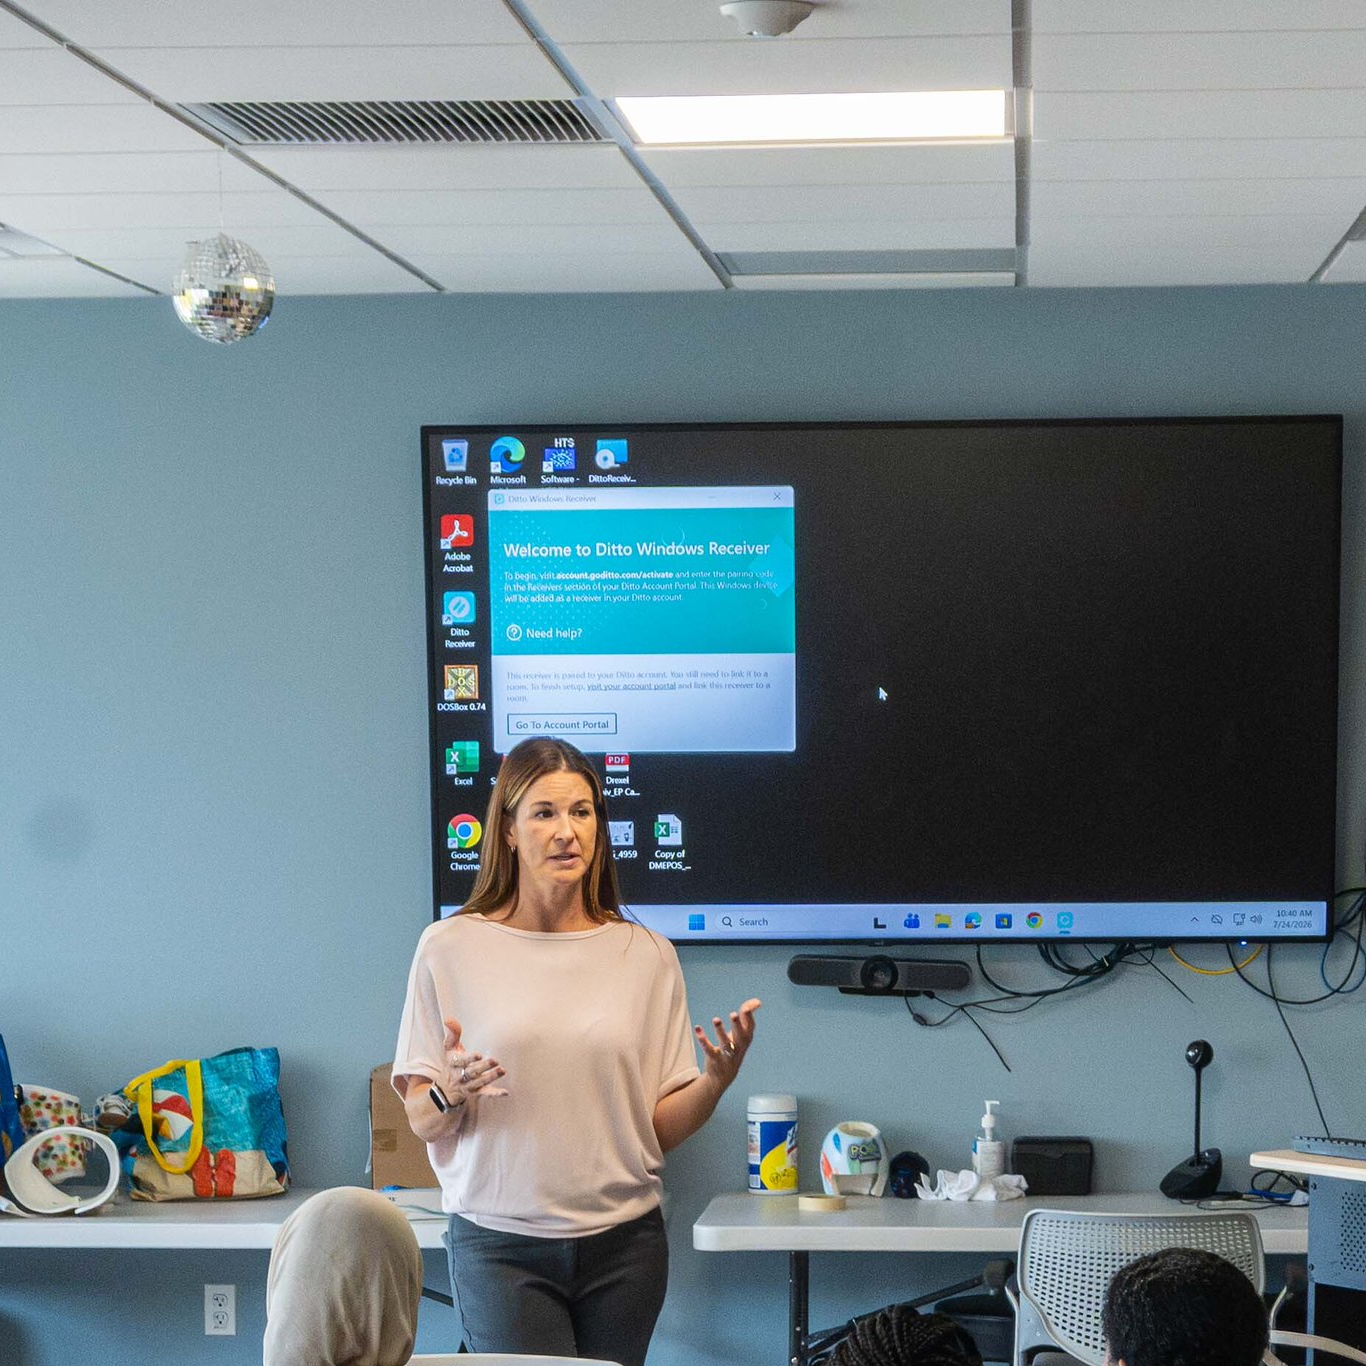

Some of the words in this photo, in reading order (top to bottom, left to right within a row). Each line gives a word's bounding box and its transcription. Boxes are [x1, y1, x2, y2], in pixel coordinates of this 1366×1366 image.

[554, 437, 575, 448] HTS
[435, 475, 463, 486] Recycle
[464, 475, 477, 485] Bin
[490, 475, 527, 484] Microsoft
[540, 474, 575, 484] Software
[503, 542, 572, 557] Welcome
[576, 544, 591, 557] to
[595, 542, 632, 556] Ditto
[636, 541, 704, 556] Windows
[709, 540, 770, 555] Receiver
[444, 552, 471, 561] Adobe
[443, 564, 473, 573] Acrobat
[505, 571, 514, 580] To
[540, 571, 555, 580] visit
[556, 570, 674, 581] account.goditto.com/activate
[675, 571, 689, 579] and
[692, 571, 710, 579] enter
[713, 570, 726, 578] the
[514, 582, 526, 590] the
[528, 582, 563, 591] Receivers
[564, 582, 591, 590] section
[592, 581, 601, 590] of
[603, 584, 619, 592] your
[621, 581, 640, 590] Ditto
[642, 581, 673, 590] Account
[700, 581, 715, 589] This
[717, 581, 752, 590] Windows
[505, 593, 518, 602] will
[530, 593, 554, 602] added
[573, 593, 602, 602] receiver
[612, 595, 630, 603] your
[632, 592, 651, 601] Ditto
[450, 628, 470, 636] Ditto
[526, 628, 553, 639] Need
[555, 628, 583, 641] help?
[445, 639, 476, 648] Receiver
[597, 672, 614, 682] your
[701, 670, 719, 678] need
[604, 683, 620, 692] your
[623, 682, 652, 690] account
[654, 682, 676, 691] portal
[694, 681, 707, 689] link
[709, 681, 723, 689] this
[725, 681, 754, 689] receiver
[437, 703, 468, 711] DOSBox
[469, 702, 486, 711] 0.74
[516, 721, 529, 730] Go
[531, 721, 541, 729] To
[543, 720, 580, 730] Account
[582, 720, 609, 729] Portal
[608, 756, 626, 764] PDF
[454, 777, 473, 786] Excel
[605, 776, 630, 785] Drexel
[450, 851, 479, 861] Google
[613, 850, 638, 860] _4959
[654, 850, 675, 859] Copy
[676, 850, 686, 858] of
[450, 863, 481, 871] Chrome
[1277, 909, 1298, 918] 10:40
[1299, 909, 1313, 918] AM
[739, 917, 769, 926] Search
